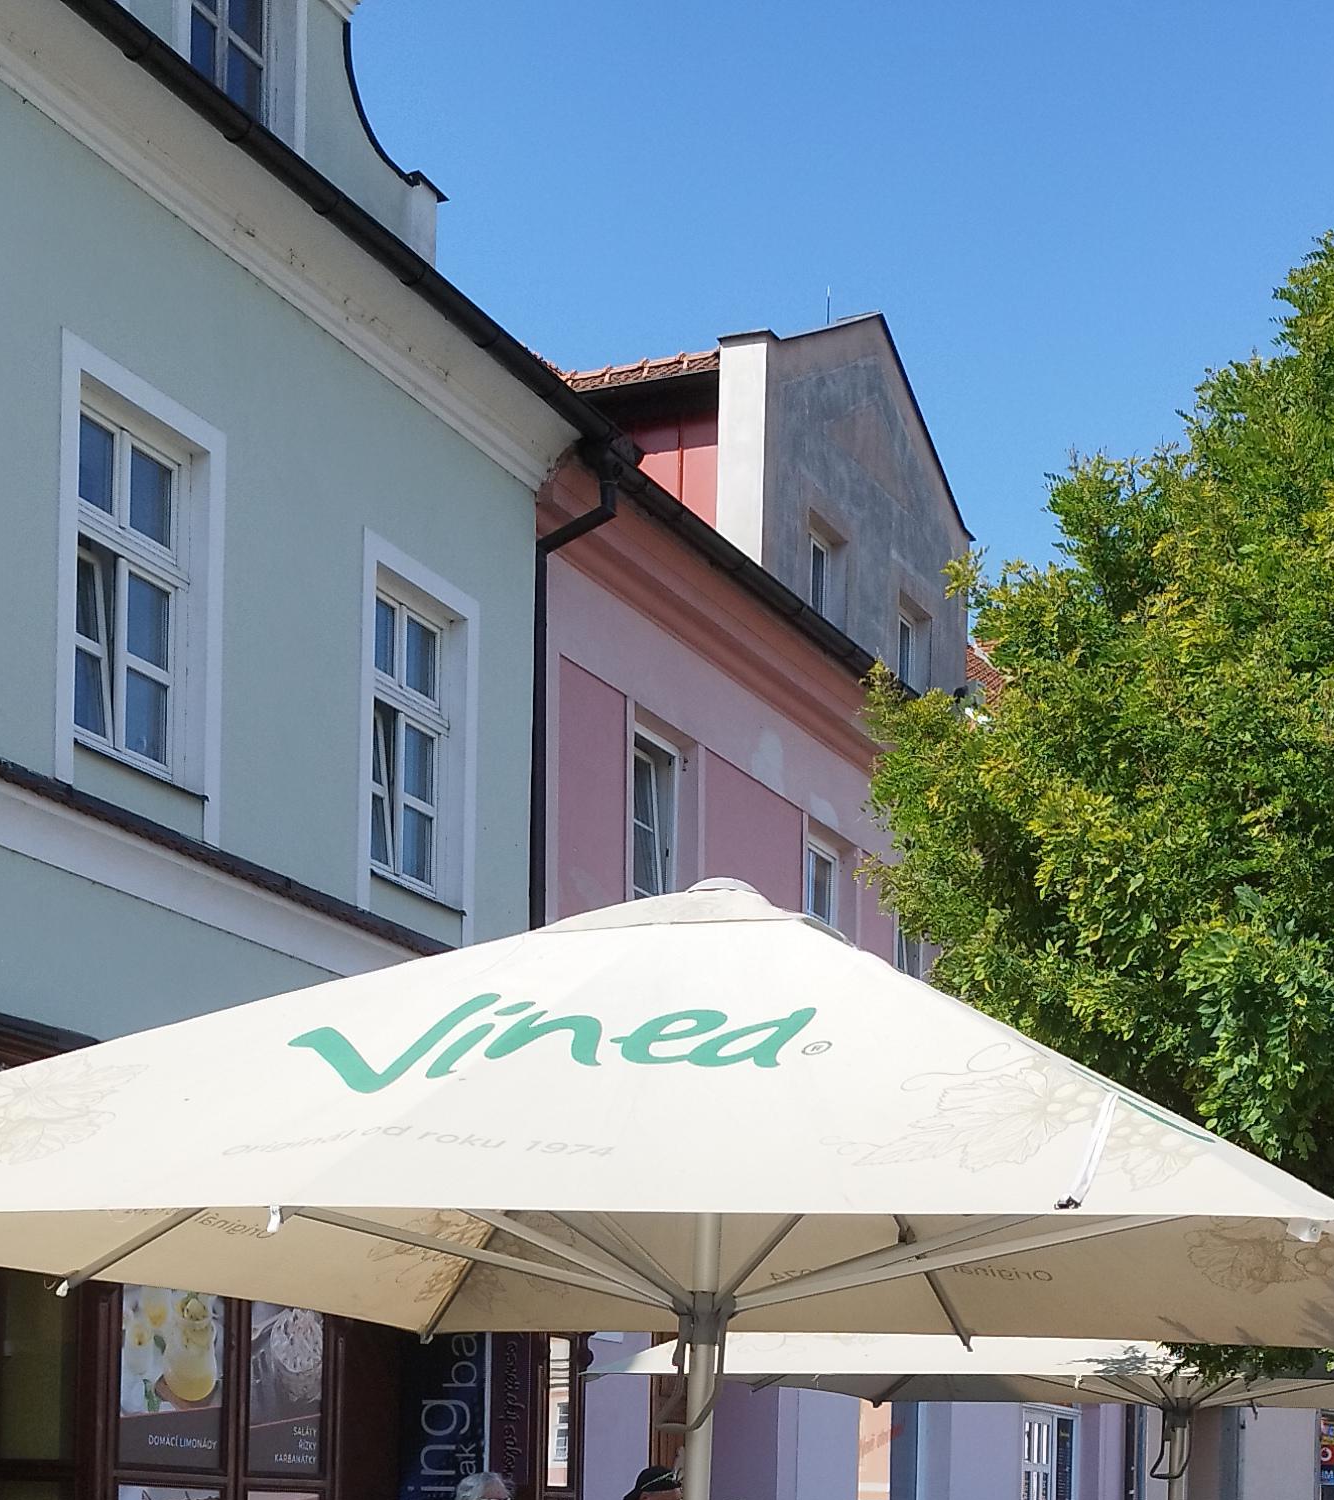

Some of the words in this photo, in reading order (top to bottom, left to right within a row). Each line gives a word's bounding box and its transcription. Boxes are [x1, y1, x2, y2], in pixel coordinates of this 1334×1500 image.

[287, 992, 817, 1094] Vinea
[361, 1124, 413, 1138] od
[417, 1131, 506, 1150] roku
[525, 1138, 615, 1158] 1974
